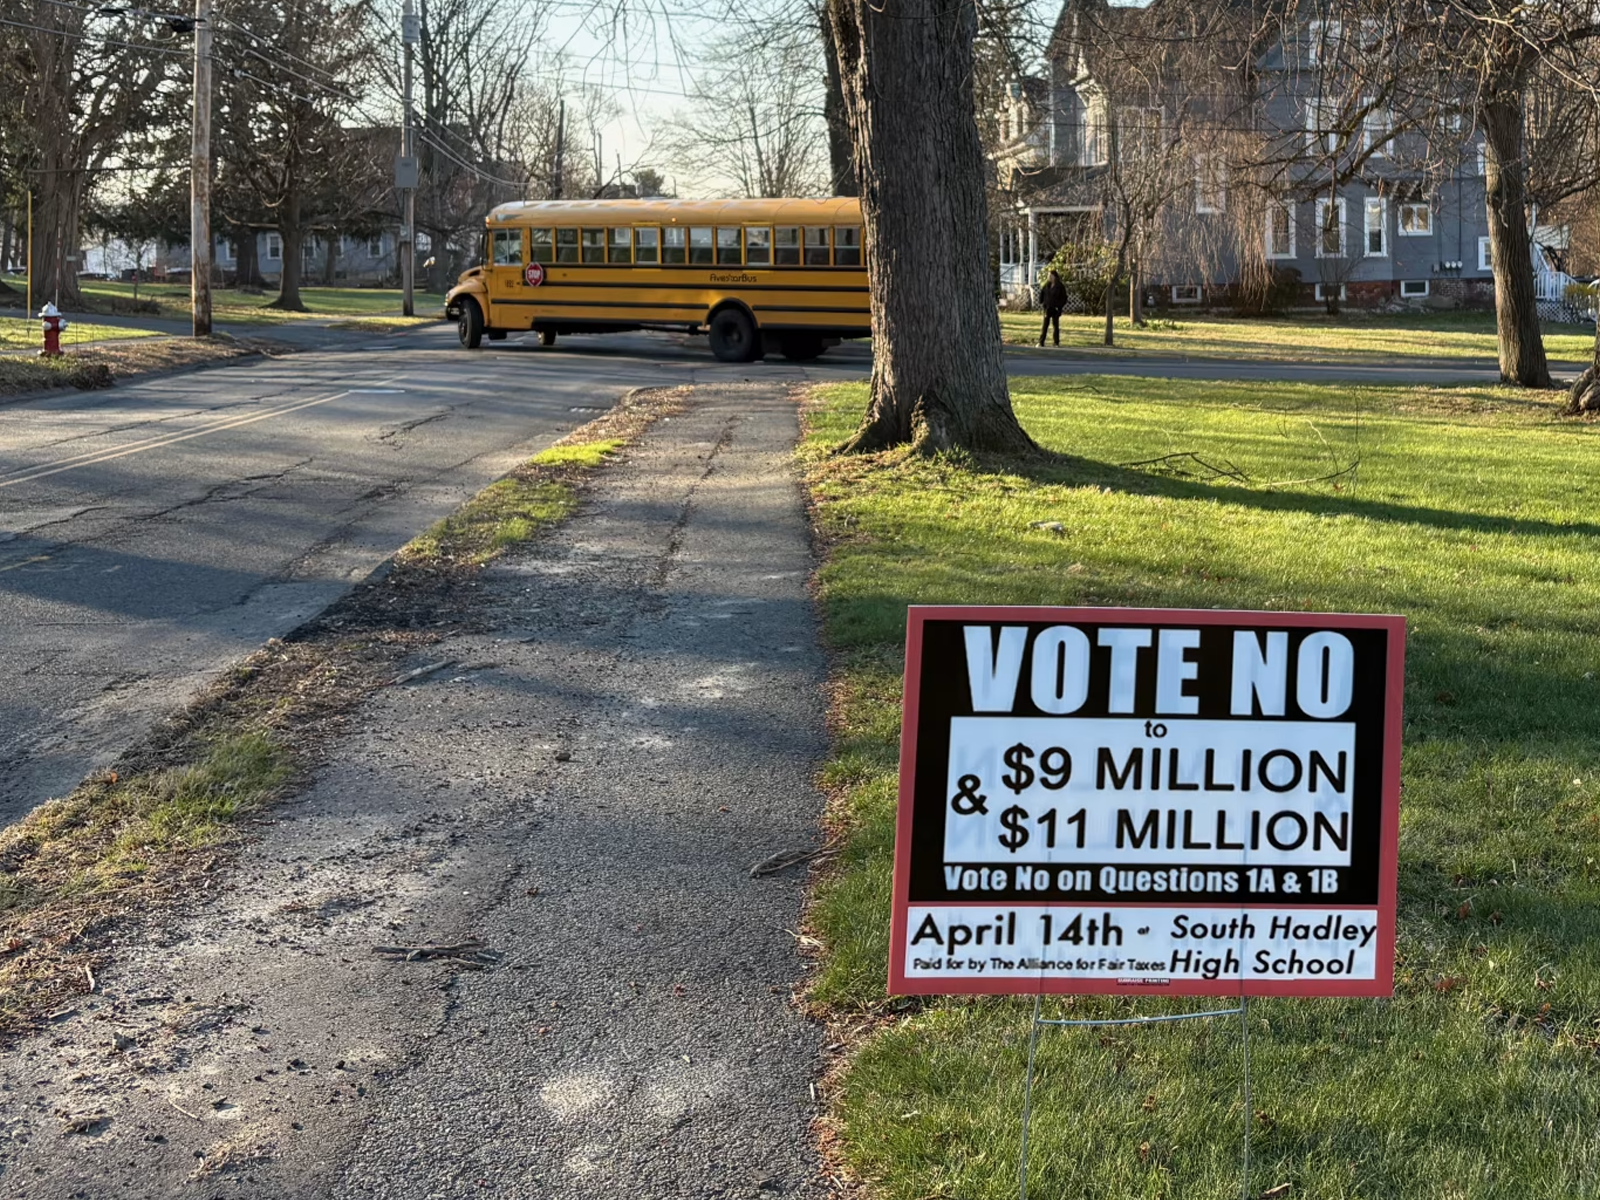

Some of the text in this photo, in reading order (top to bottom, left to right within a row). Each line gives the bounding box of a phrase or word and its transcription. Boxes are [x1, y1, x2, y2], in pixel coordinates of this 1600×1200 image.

[527, 269, 541, 279] STOP
[963, 625, 1355, 719] VOTE NO
[1144, 720, 1168, 738] to
[1001, 743, 1348, 794] $9 MILLION
[950, 774, 989, 815] &
[997, 805, 1349, 853] $11 MILLION
[943, 866, 1339, 894] Vote No on Questions 1A & 1B
[910, 911, 1151, 955] April 14th at
[1170, 914, 1377, 947] South Hadley
[913, 957, 1166, 973] Paid for by The Alliance for Fair Taxes
[1169, 949, 1355, 979] High School
